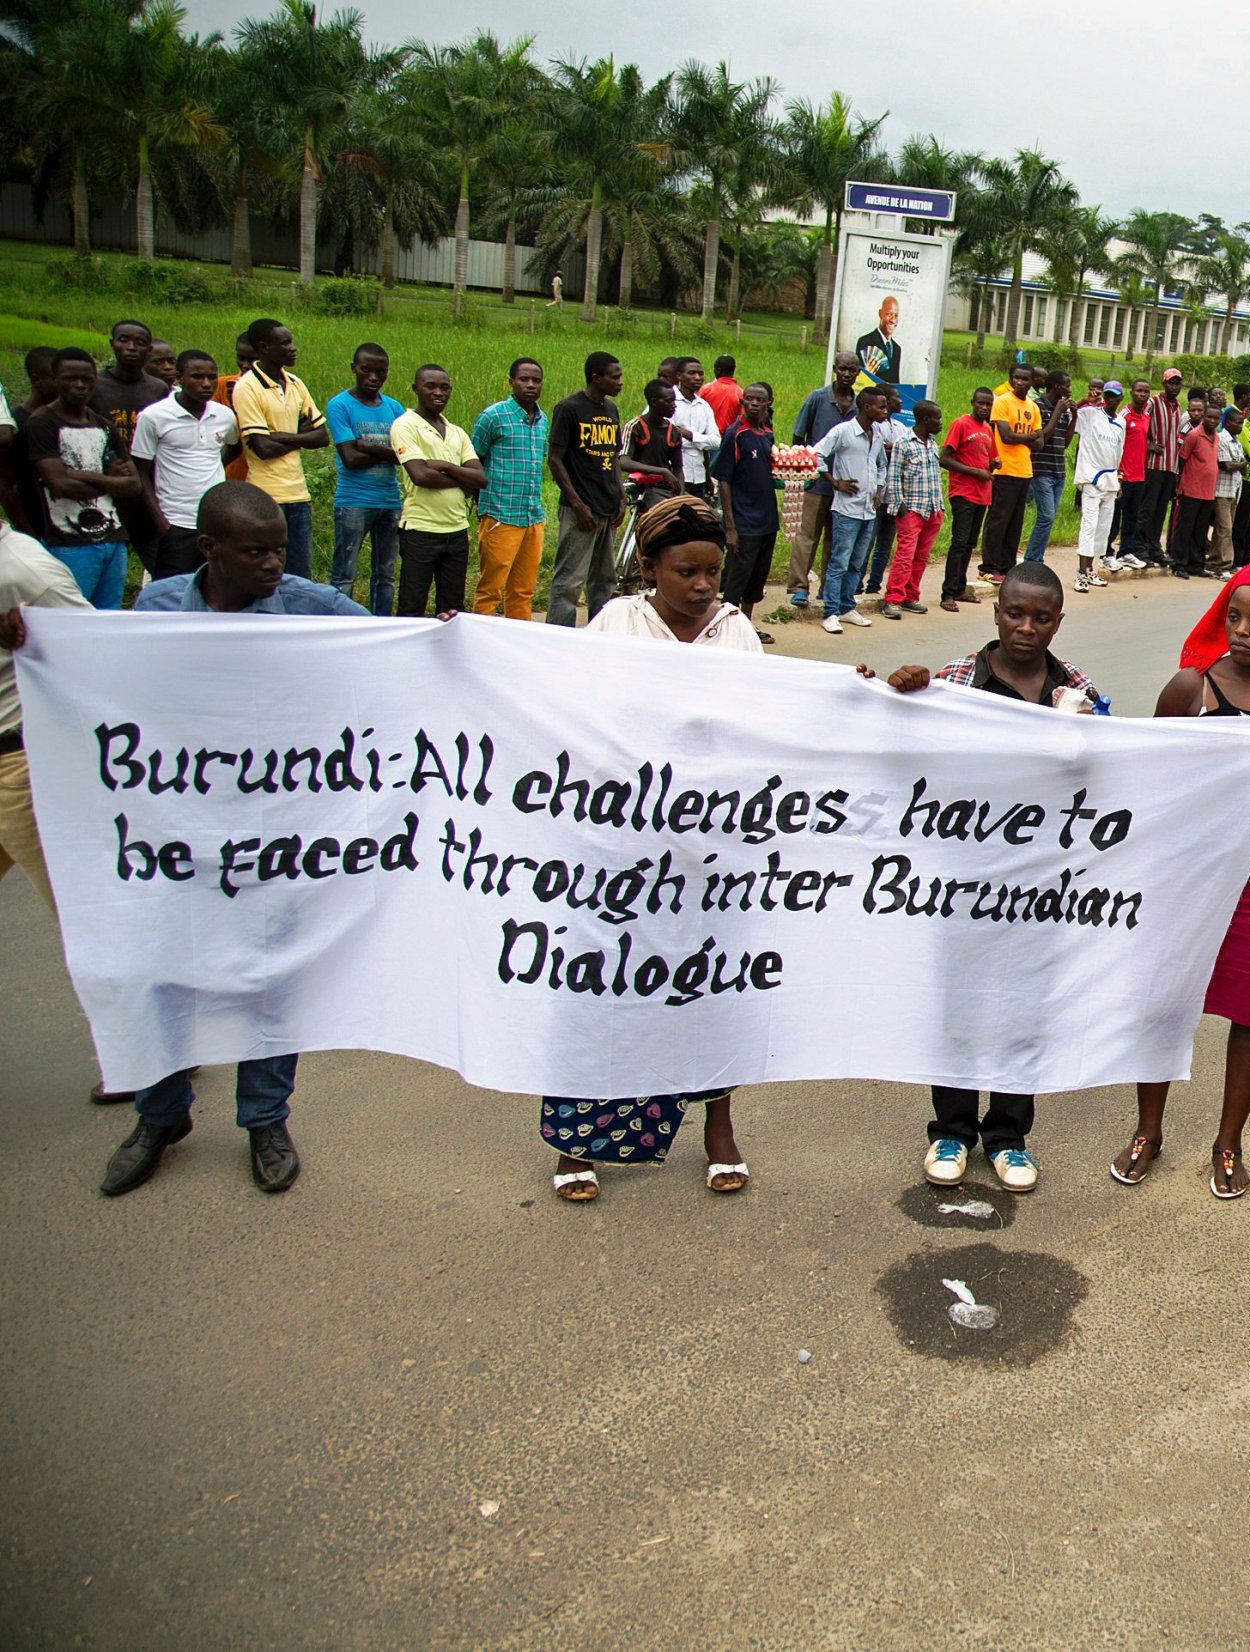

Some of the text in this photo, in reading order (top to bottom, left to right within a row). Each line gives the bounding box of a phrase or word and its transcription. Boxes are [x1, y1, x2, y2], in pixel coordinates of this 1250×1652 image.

[865, 194, 933, 212] AVENUE DE LA NATION
[867, 257, 920, 275] Opportunities
[869, 242, 920, 260] Multiply your
[513, 750, 849, 845] challenges
[900, 777, 1045, 844] have
[1059, 788, 1132, 852] to
[115, 814, 194, 882] be
[439, 819, 686, 924] through
[699, 851, 853, 914] inter
[863, 854, 1142, 930] Burundian
[499, 919, 783, 1006] Dialogue
